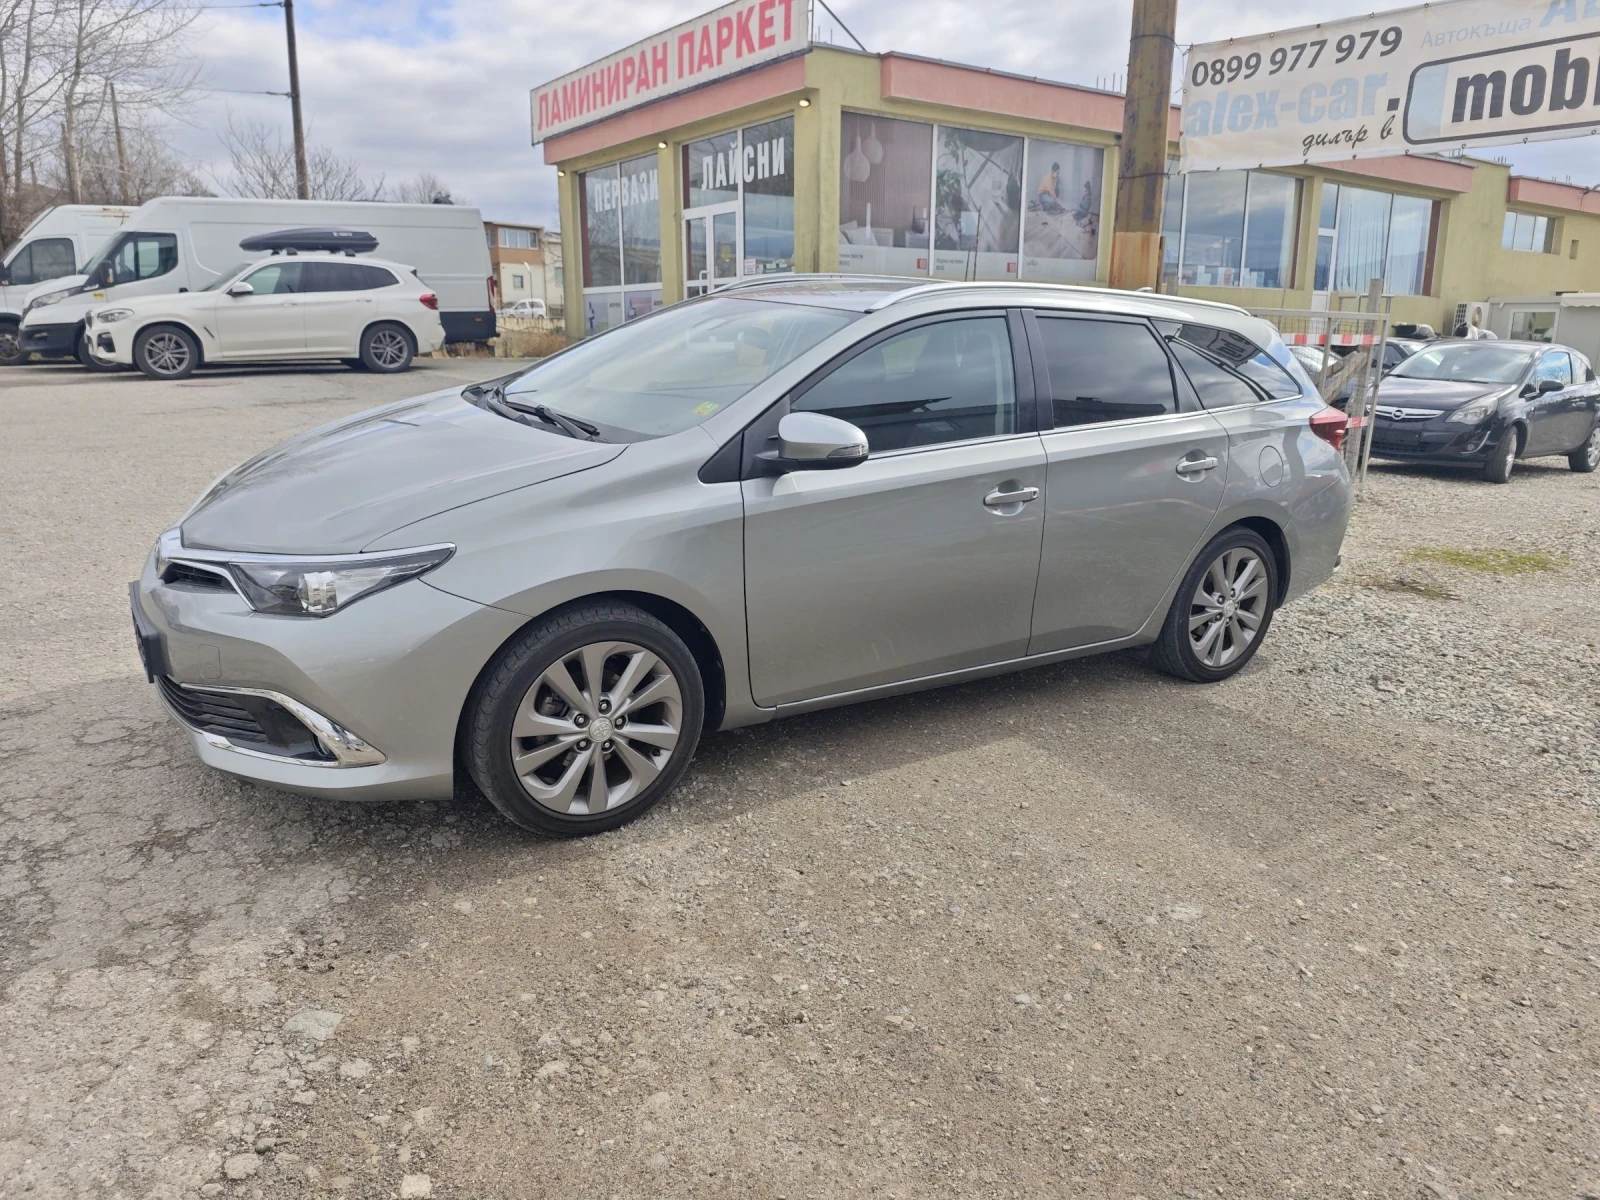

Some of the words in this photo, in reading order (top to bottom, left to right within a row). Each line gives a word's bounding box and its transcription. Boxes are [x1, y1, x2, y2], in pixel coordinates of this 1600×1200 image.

[1191, 52, 1262, 87] 0899
[1268, 38, 1328, 76] 977
[1335, 26, 1403, 64] 979
[1421, 17, 1532, 49] Автокъща
[537, 41, 668, 132] ЛАМИНИРАН
[678, 0, 792, 79] ПАРКЕТ
[1302, 124, 1369, 156] дилър
[1380, 114, 1394, 140] в
[701, 137, 785, 191] ЛАЙСНИ
[595, 168, 659, 213] ПЕРВАЗИ
